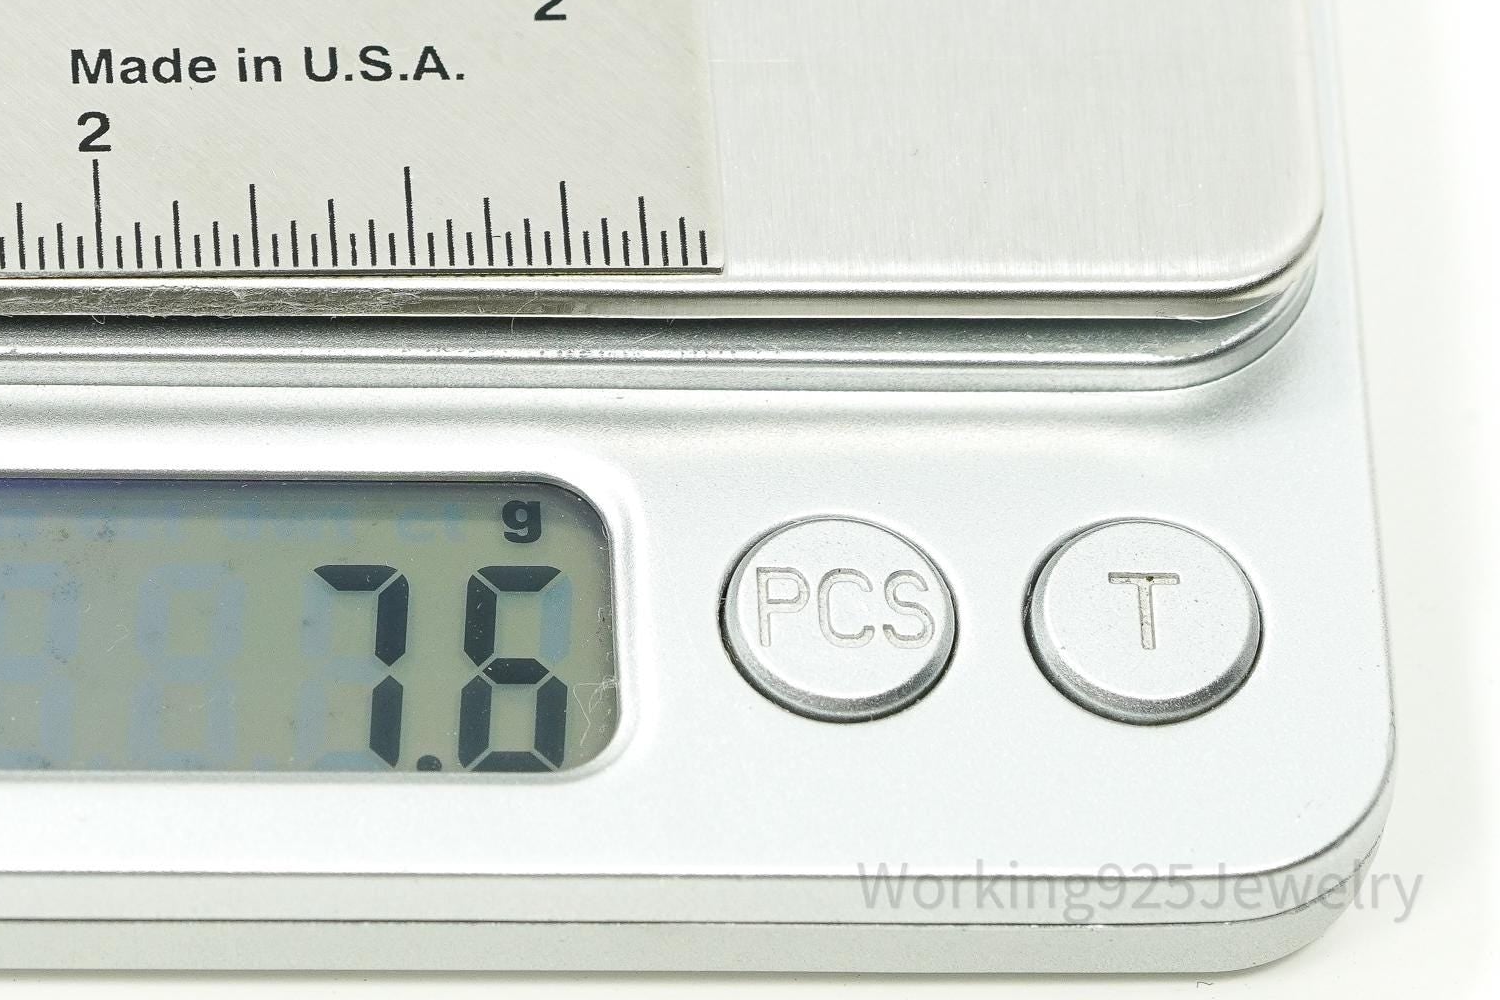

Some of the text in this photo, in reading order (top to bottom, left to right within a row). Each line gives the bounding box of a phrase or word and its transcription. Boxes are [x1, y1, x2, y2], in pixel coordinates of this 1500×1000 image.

[70, 45, 465, 85] Made in U.S.A.
[77, 111, 112, 153] 2
[501, 498, 543, 544] g
[755, 566, 937, 650] PCS
[1107, 571, 1182, 651] T
[313, 564, 568, 772] 7.6
